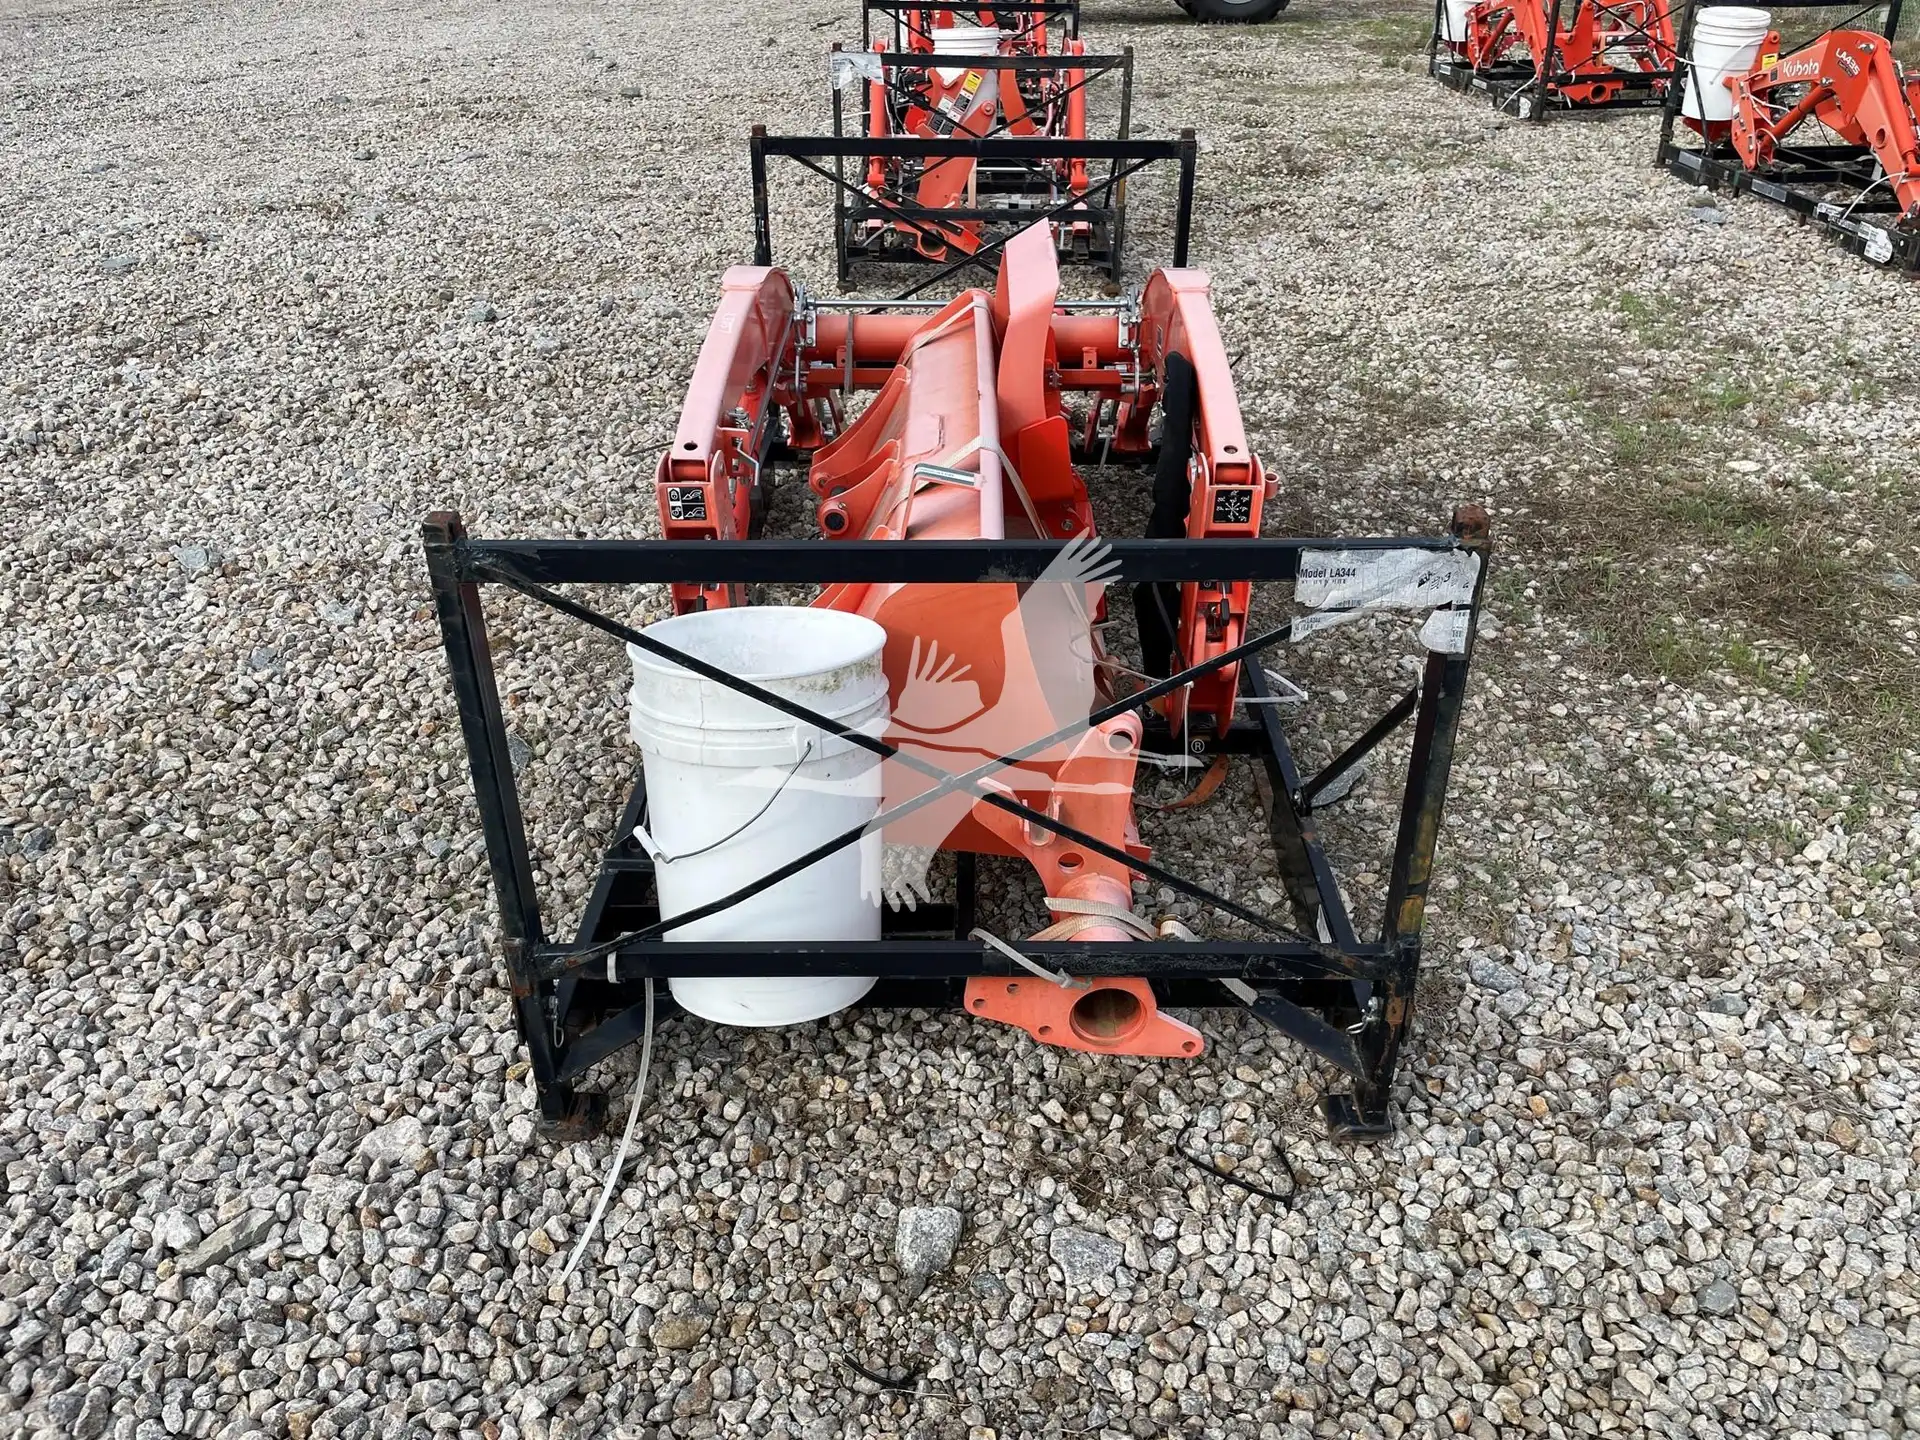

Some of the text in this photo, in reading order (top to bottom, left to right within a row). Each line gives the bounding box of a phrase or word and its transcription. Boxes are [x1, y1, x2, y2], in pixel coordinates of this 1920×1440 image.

[1783, 58, 1819, 77] Kubota
[1835, 48, 1860, 76] LA435
[1300, 567, 1356, 578] Model LA344
